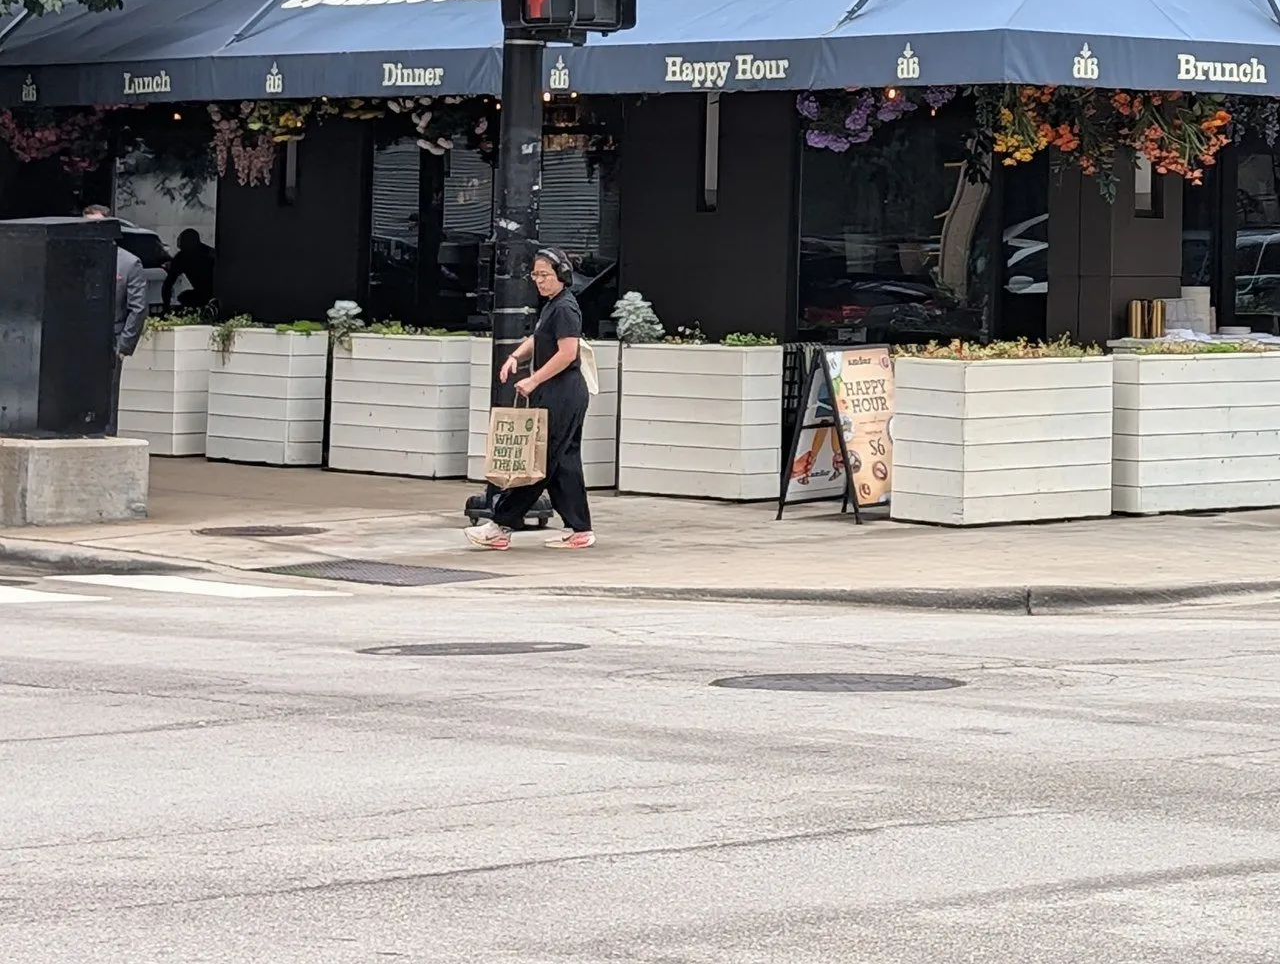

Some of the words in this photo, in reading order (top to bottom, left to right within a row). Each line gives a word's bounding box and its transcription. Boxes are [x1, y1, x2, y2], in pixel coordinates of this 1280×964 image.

[382, 62, 444, 87] Dinner
[665, 56, 731, 88] Happy
[734, 54, 789, 81] Hour
[1176, 53, 1268, 84] Brunch
[123, 69, 171, 95] Lunch
[844, 379, 886, 396] HAPPY
[852, 396, 889, 413] HOUR
